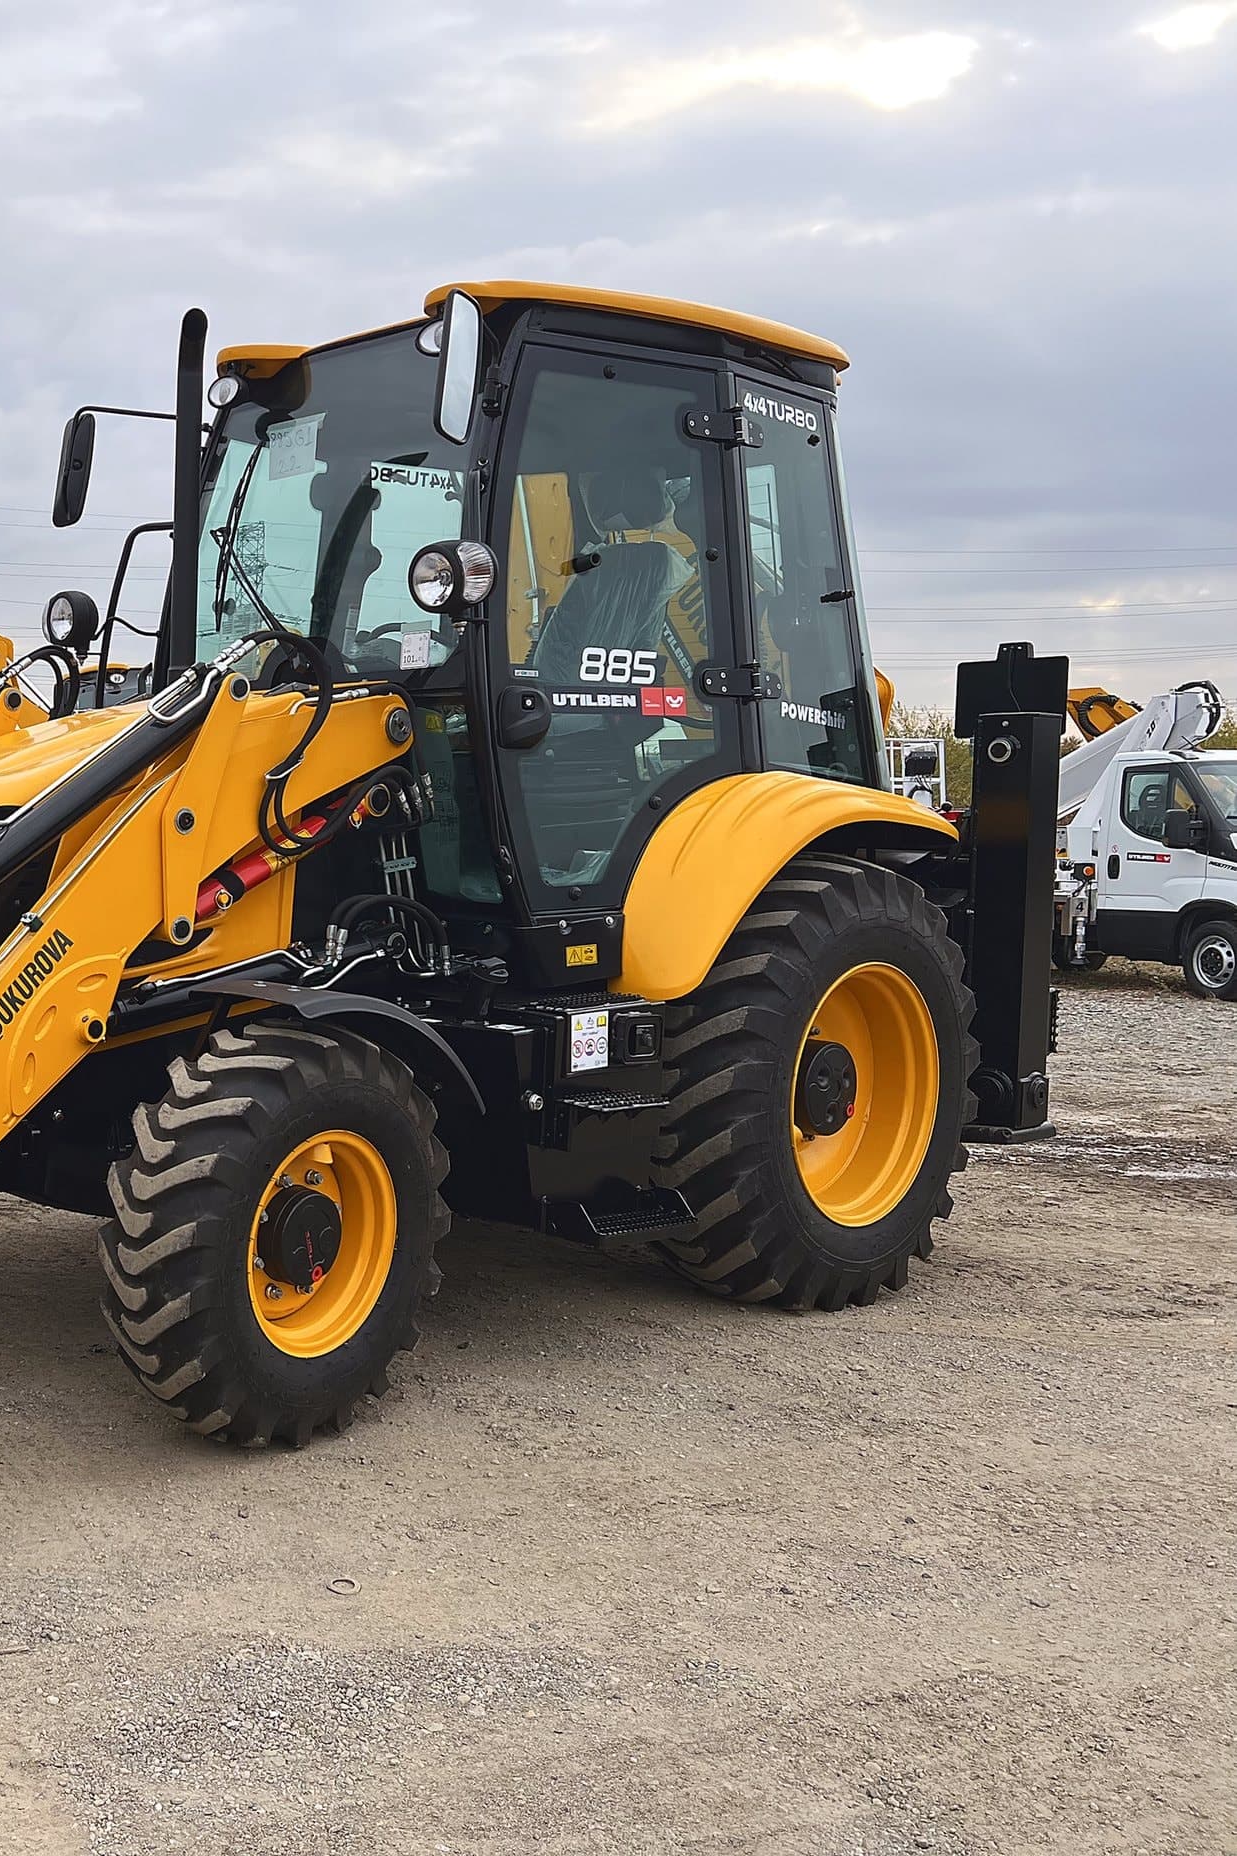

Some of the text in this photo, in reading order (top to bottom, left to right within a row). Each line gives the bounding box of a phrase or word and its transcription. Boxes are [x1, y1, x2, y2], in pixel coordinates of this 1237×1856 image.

[744, 392, 817, 431] 4x4TURBO
[579, 647, 657, 684] 885
[663, 621, 694, 680] TILBEN
[552, 693, 637, 707] UTILBEN
[1076, 901, 1084, 912] 4
